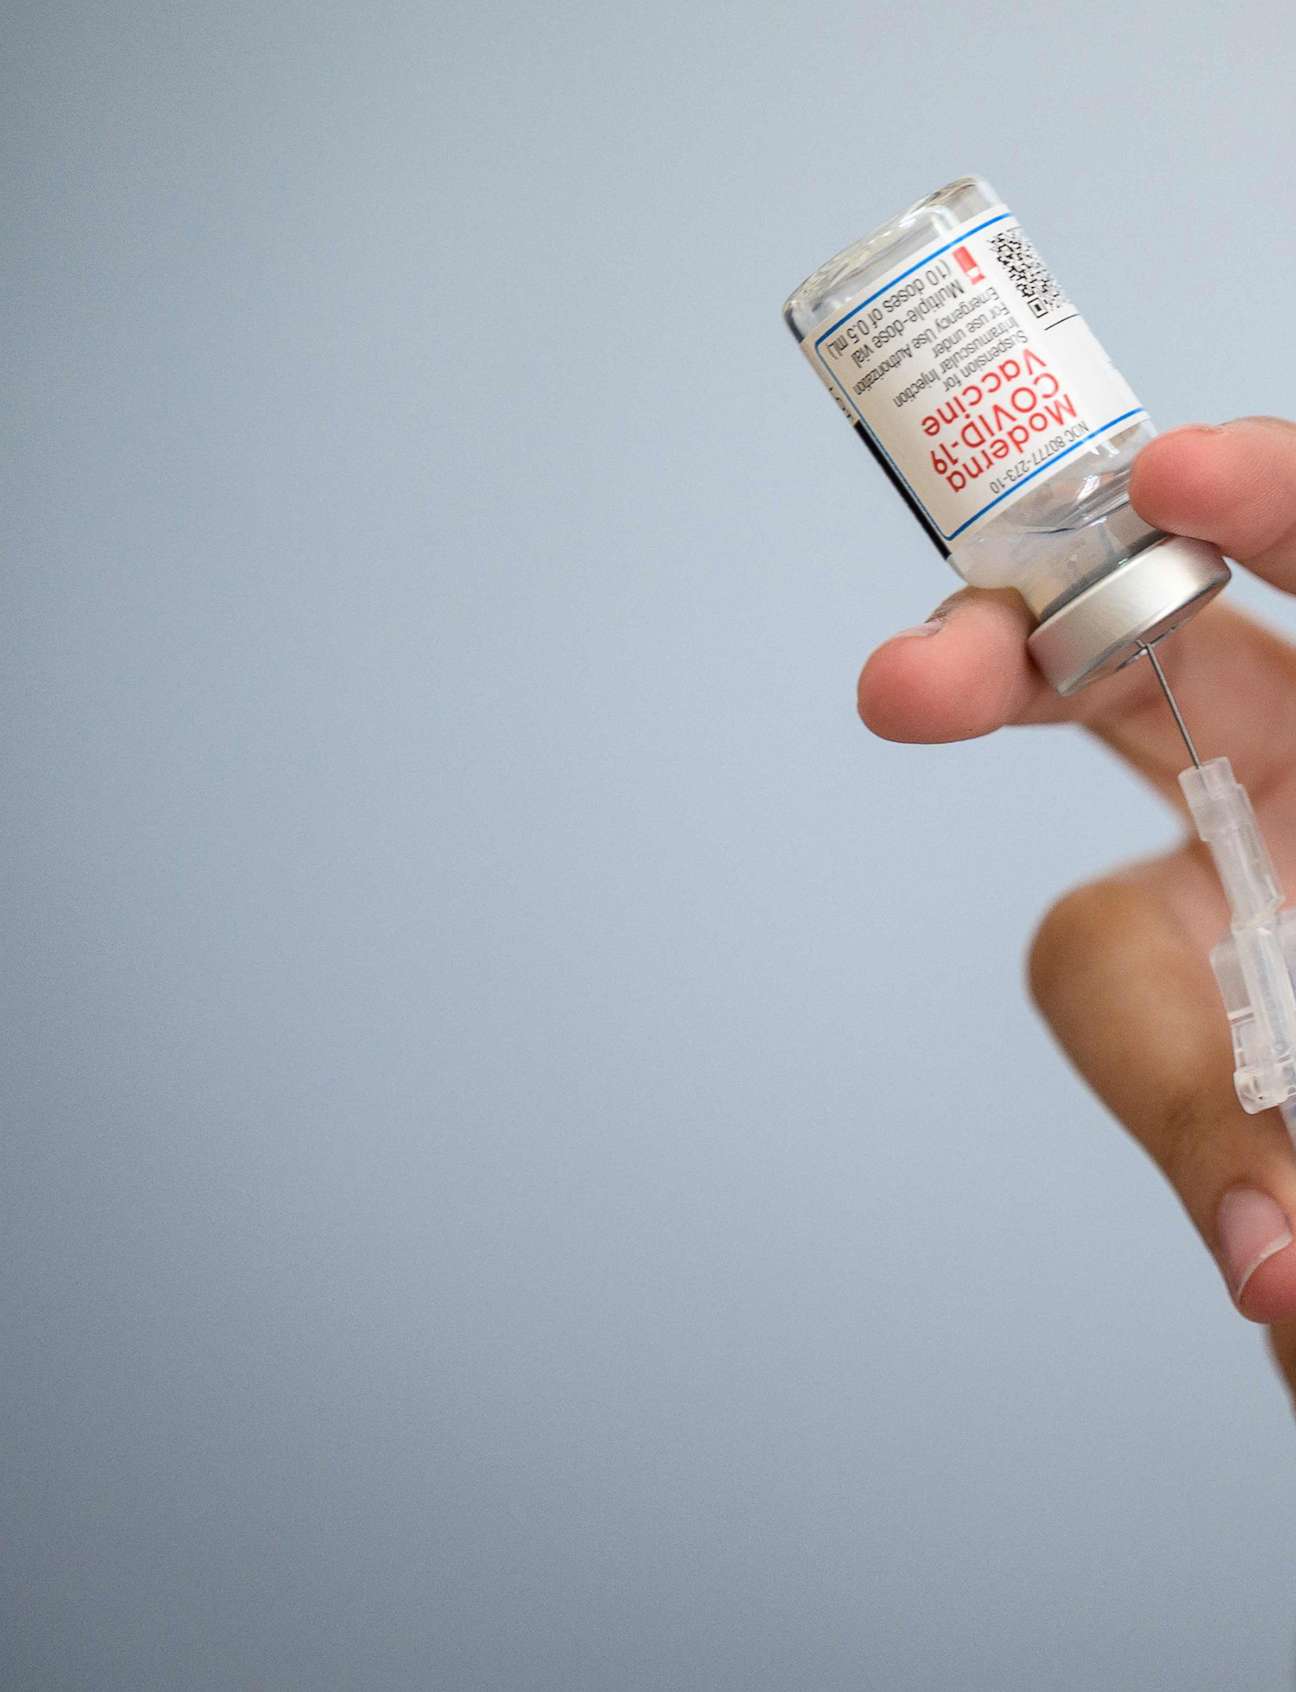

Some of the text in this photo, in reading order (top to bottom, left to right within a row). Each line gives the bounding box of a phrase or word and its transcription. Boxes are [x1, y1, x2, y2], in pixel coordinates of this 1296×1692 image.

[881, 276, 927, 317] doses
[923, 258, 951, 287] (10
[844, 318, 871, 345] 0.5
[850, 278, 964, 369] Multiple-dose vial
[851, 285, 999, 396] Emergency Use Authorization
[865, 306, 886, 329] of
[930, 300, 1010, 358] For use under
[937, 314, 1019, 375] Intramuscular
[891, 368, 940, 409] Injection
[941, 328, 1028, 393] Suspension for
[918, 348, 1046, 439] Vaccine
[925, 369, 1062, 476] COVID-19
[945, 392, 1079, 493] Moderna
